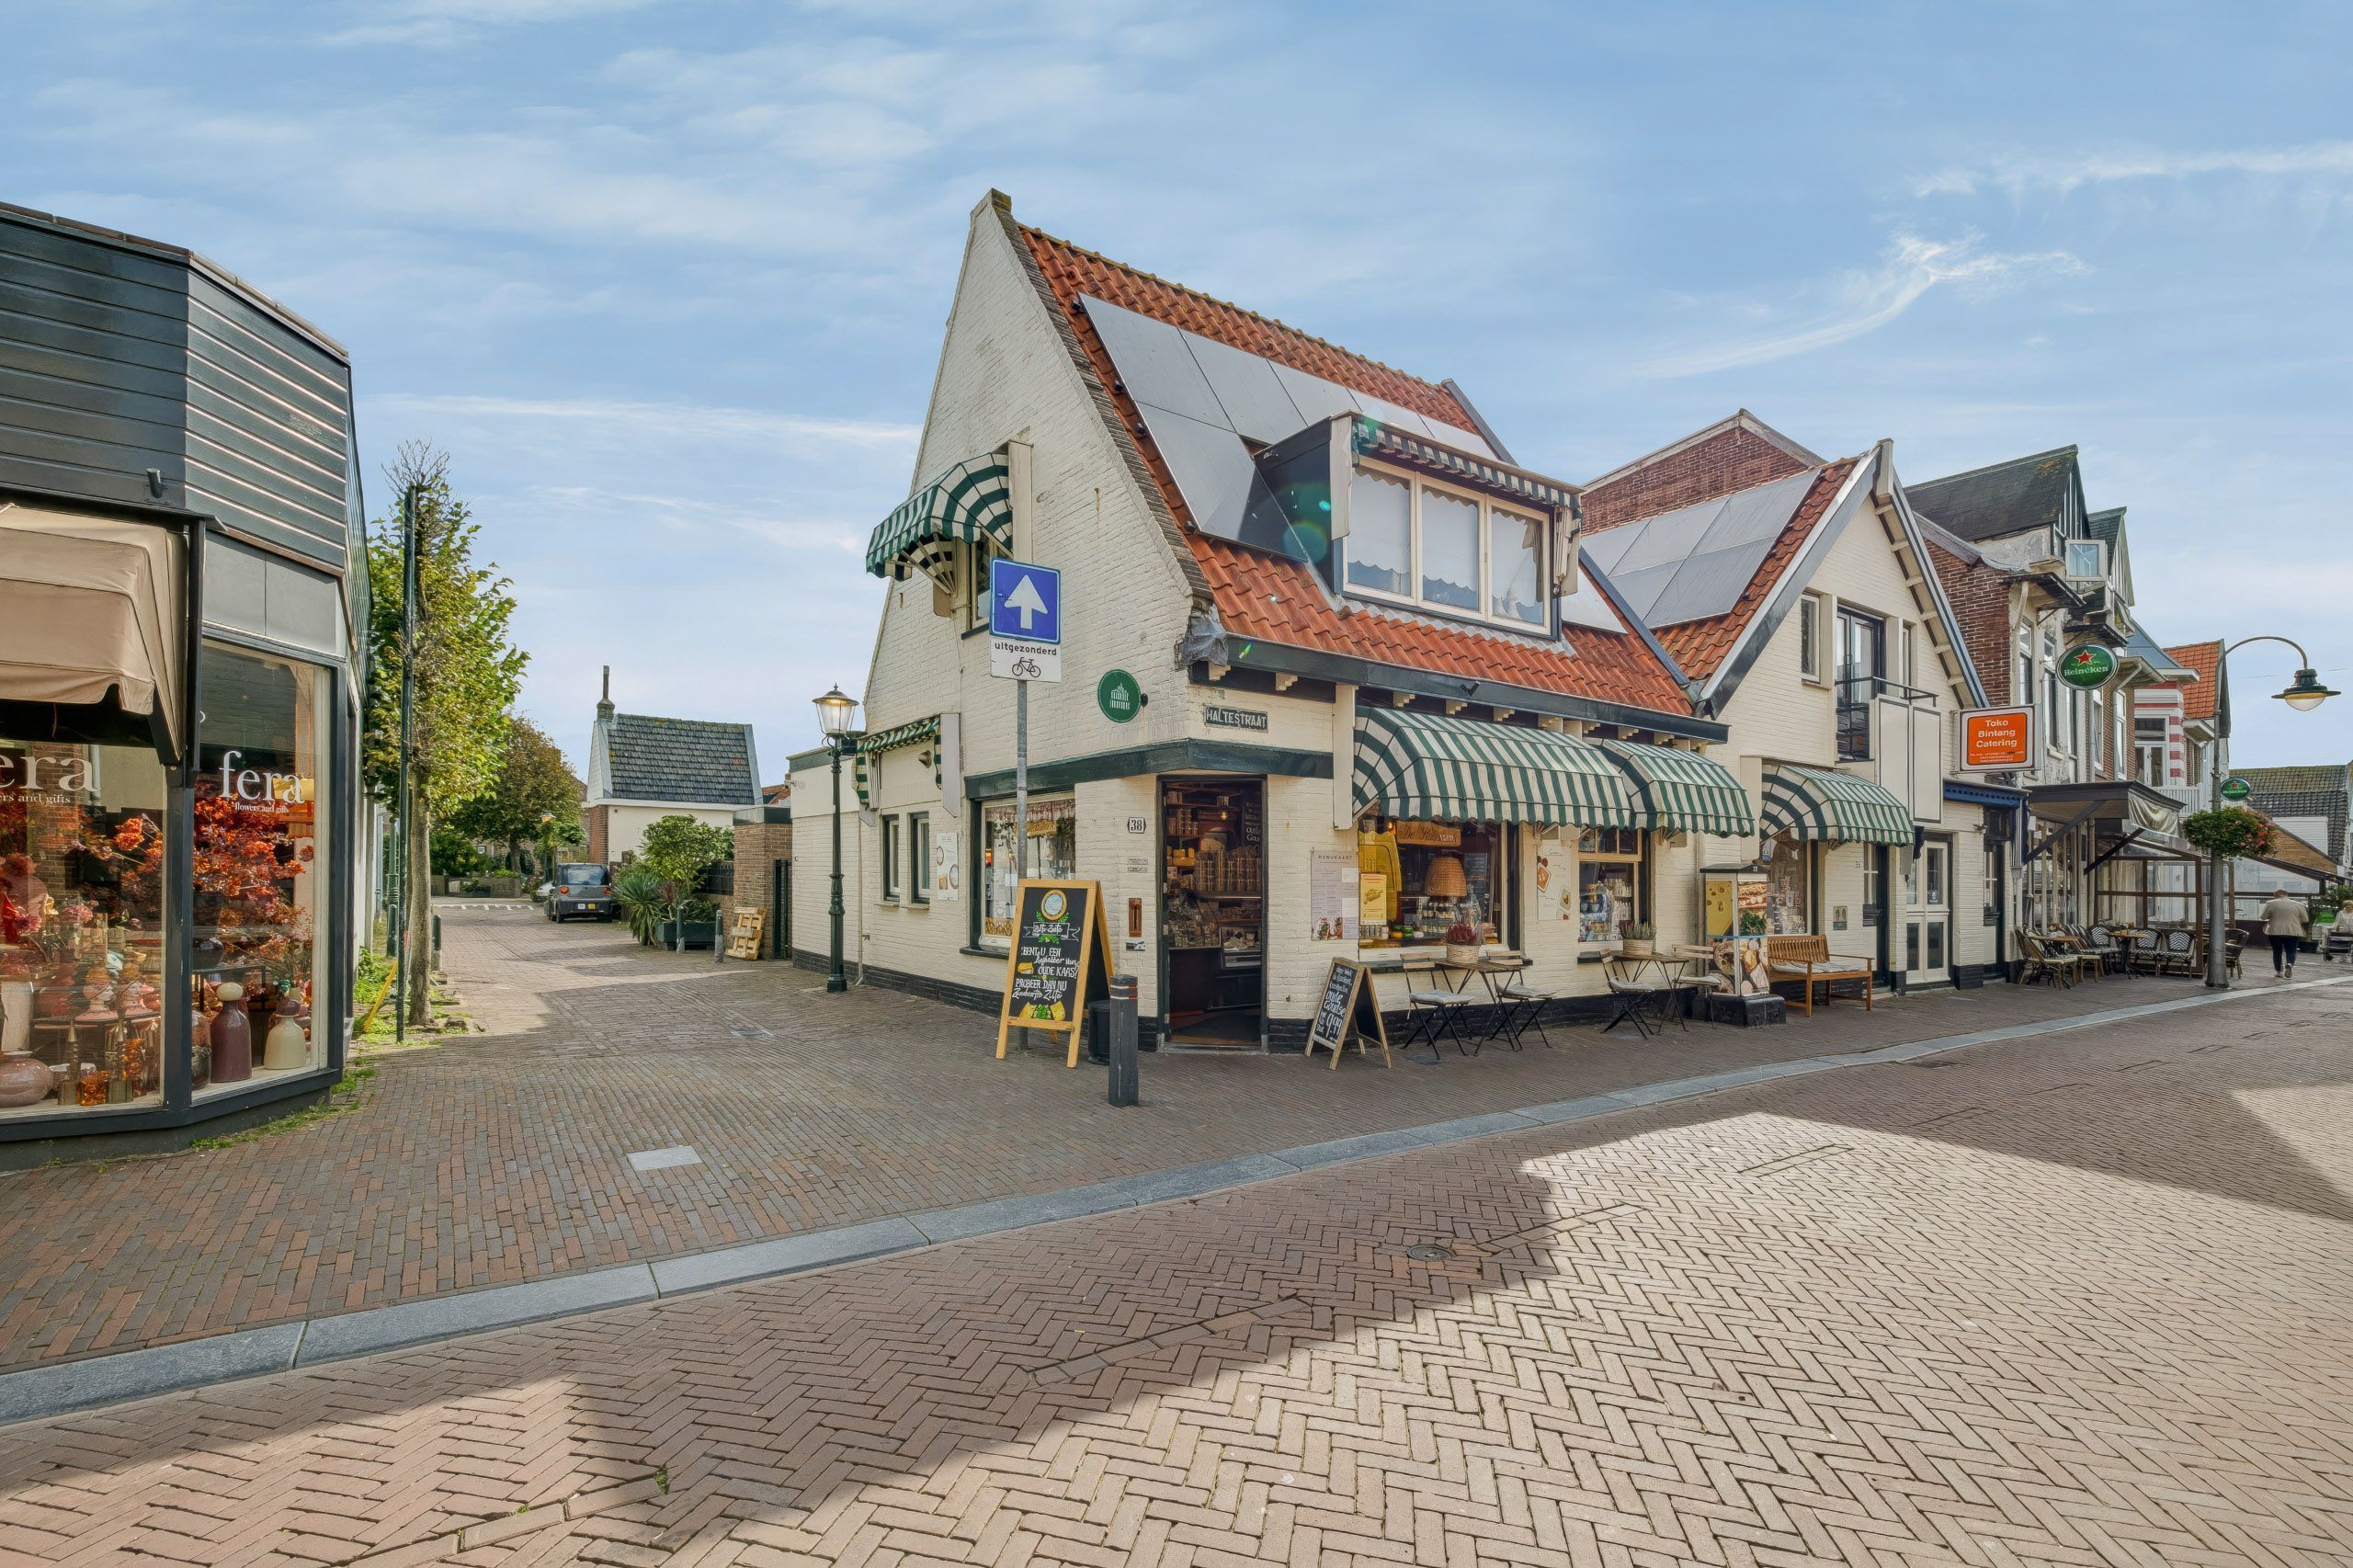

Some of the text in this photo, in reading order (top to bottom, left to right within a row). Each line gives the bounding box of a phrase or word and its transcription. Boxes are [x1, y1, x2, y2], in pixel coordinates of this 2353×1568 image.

[995, 642, 1057, 655] uitgezonderd
[2063, 666, 2109, 676] Heineken
[1206, 708, 1267, 728] HALTESTRAAT
[1978, 730, 2016, 738] Bintang
[1976, 739, 2018, 748] Catering
[219, 750, 305, 804] fera
[17, 794, 41, 802] and
[1131, 819, 1142, 832] 38
[1040, 947, 1046, 956] U
[1049, 948, 1062, 957] EEN
[1038, 966, 1055, 976] OUDE
[1015, 978, 1067, 991] PROBEER DAN NU
